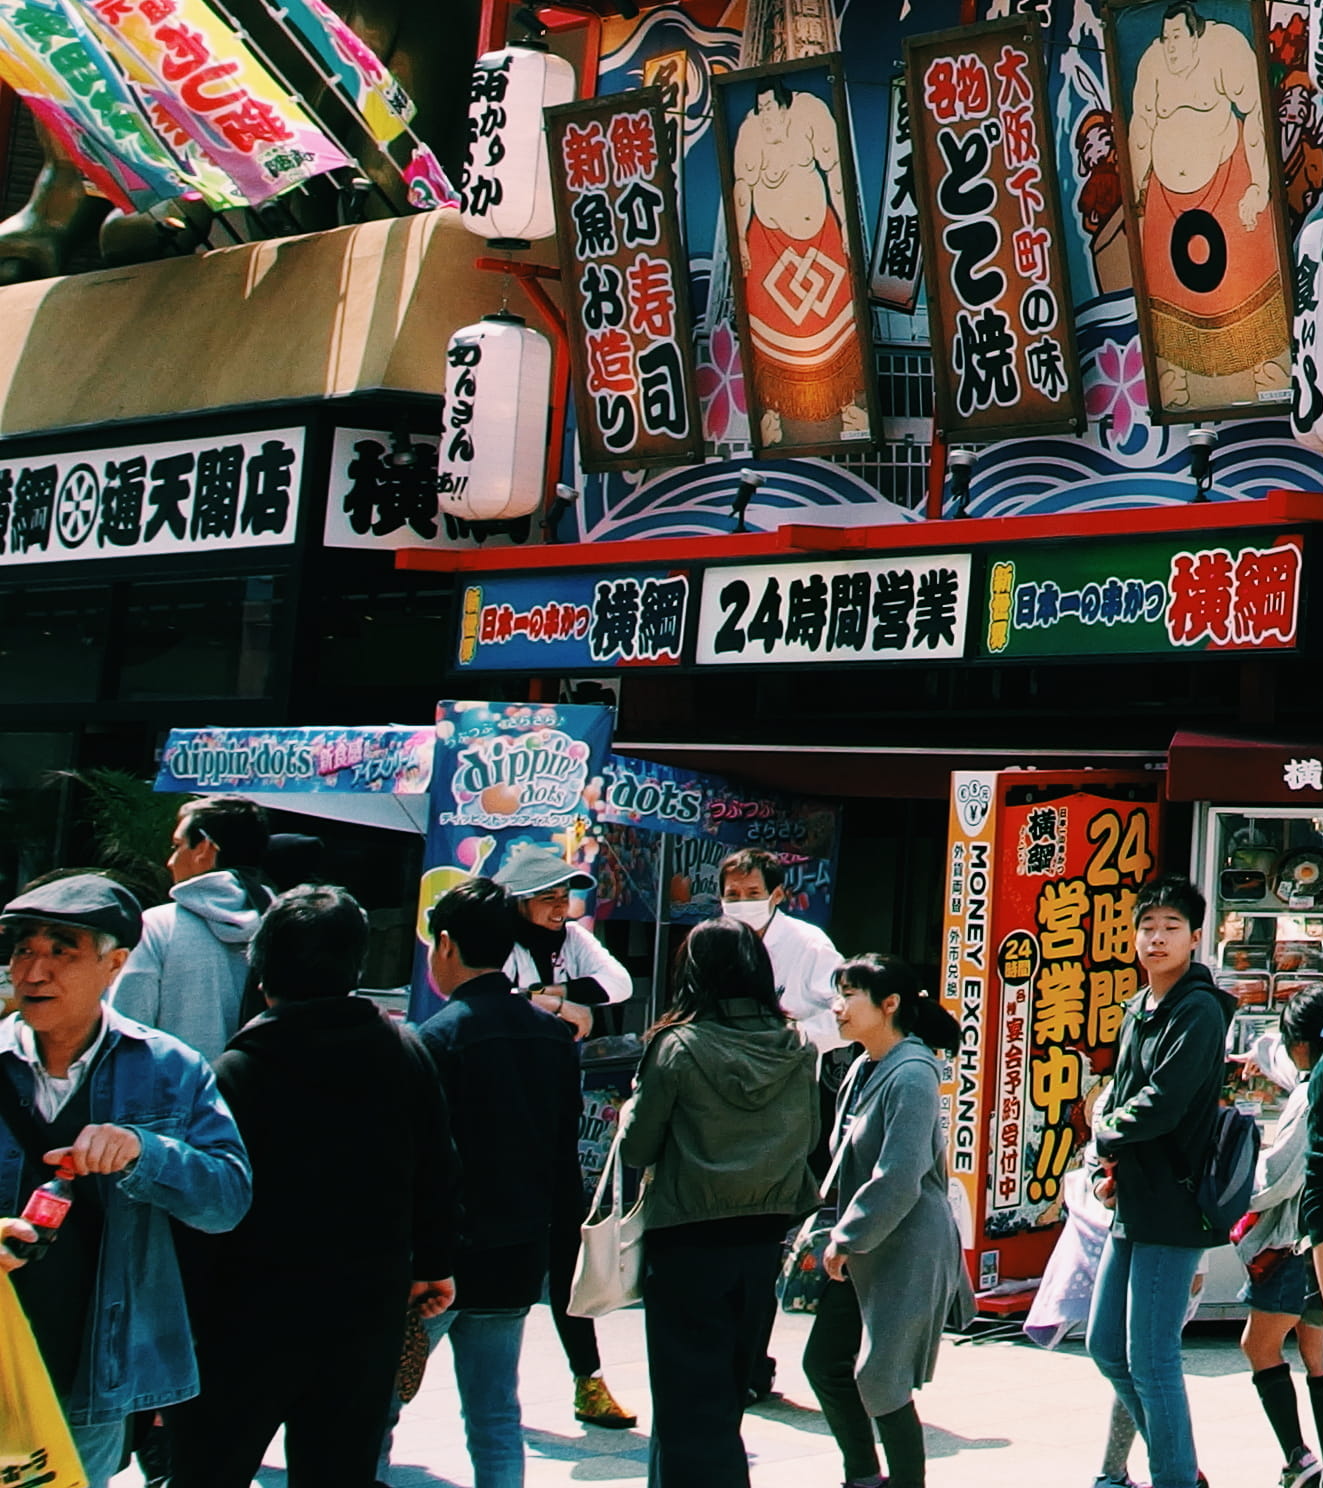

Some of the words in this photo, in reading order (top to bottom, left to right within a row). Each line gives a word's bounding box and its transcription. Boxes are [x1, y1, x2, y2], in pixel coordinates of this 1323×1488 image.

[924, 52, 992, 126] 名物
[994, 45, 1070, 402] 大阪下町の味
[579, 262, 639, 456] お造り
[99, 439, 296, 550] 通天閣店
[479, 603, 591, 646] 日本一の串かつ
[589, 576, 688, 661] 横綱
[712, 569, 961, 656] 24時間営業
[1014, 577, 1167, 629] 日本一の串かつ
[1167, 542, 1302, 646] 横綱
[519, 783, 566, 806] dots
[1026, 806, 1058, 876] 横綱
[963, 844, 990, 964] MONEY
[1003, 939, 1033, 961] 24
[954, 981, 984, 1174] EXCHANGE
